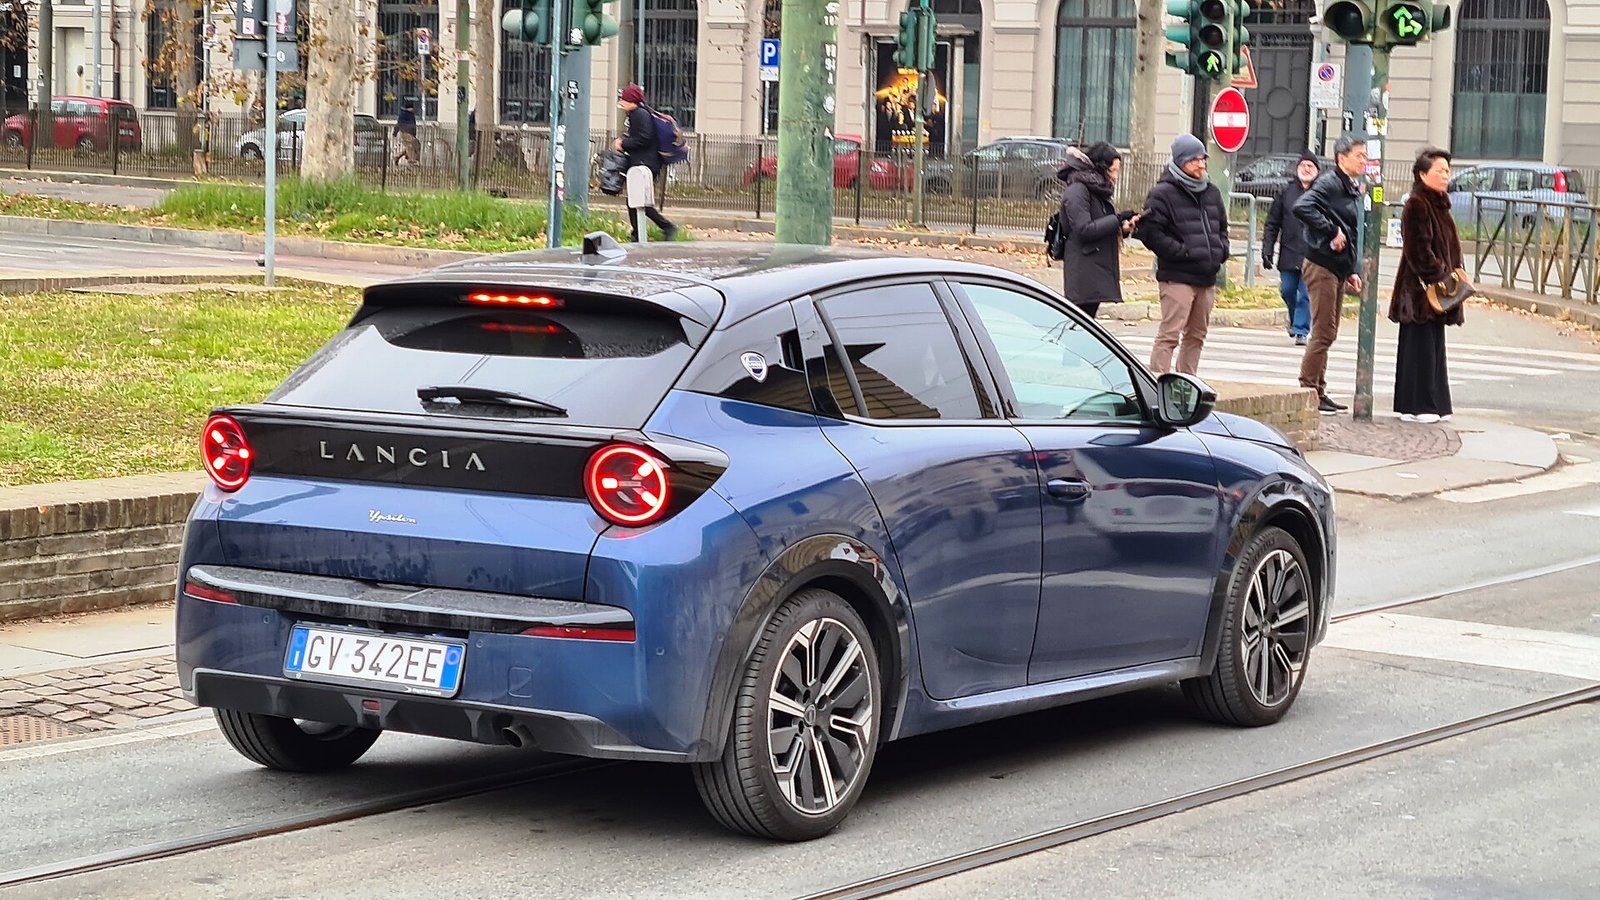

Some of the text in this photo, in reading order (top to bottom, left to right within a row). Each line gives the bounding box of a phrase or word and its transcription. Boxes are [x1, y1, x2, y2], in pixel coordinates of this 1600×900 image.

[764, 42, 776, 64] P
[319, 440, 486, 471] LANCIA
[368, 509, 417, 524] Ypsilon
[307, 635, 442, 683] GV 342EE
